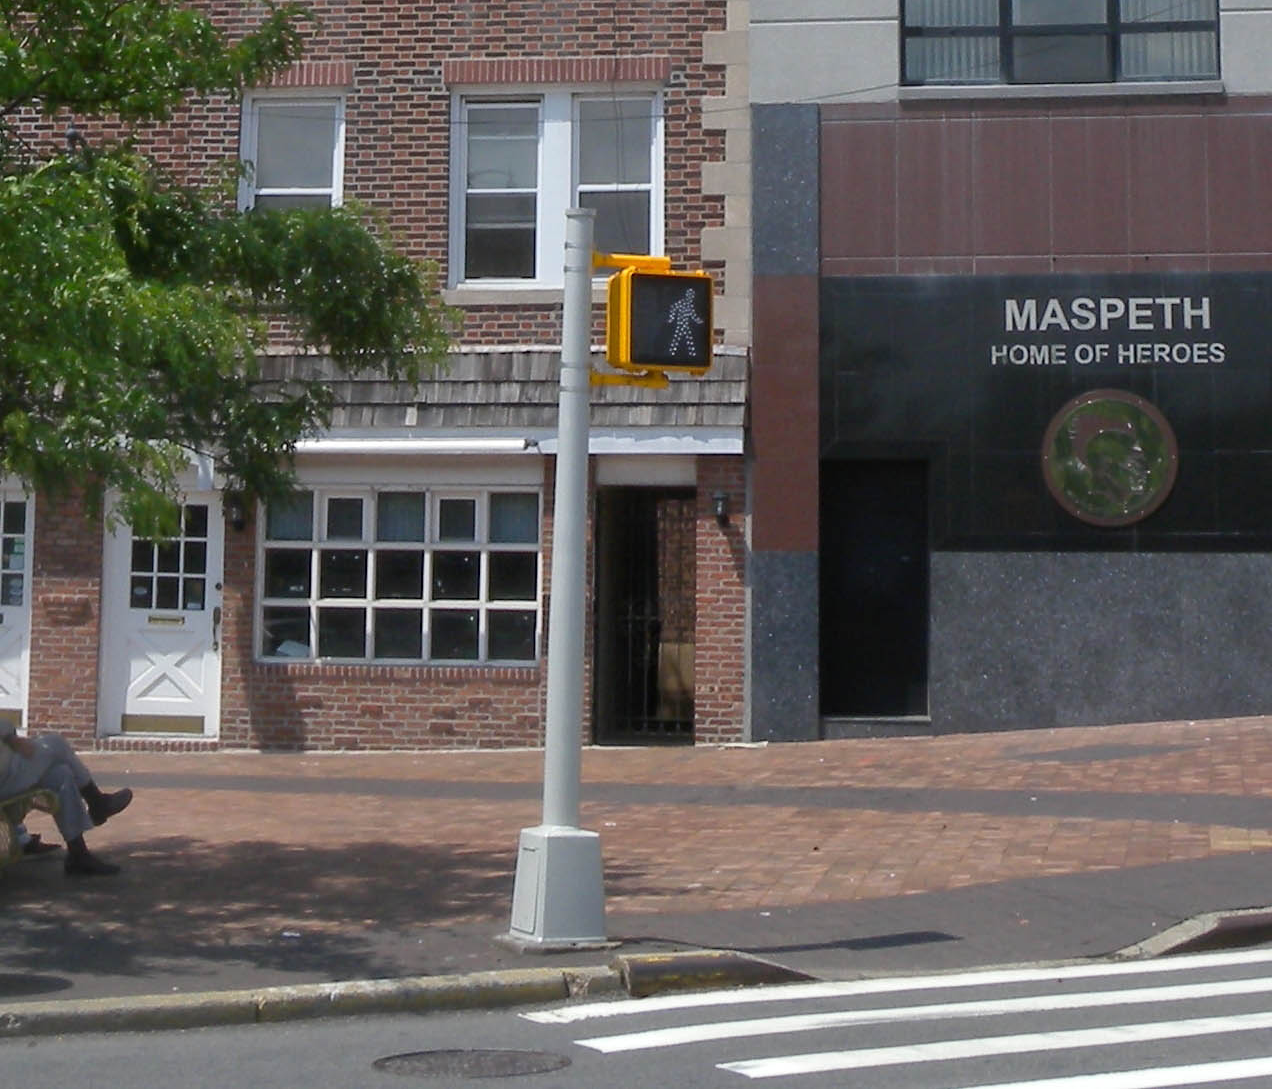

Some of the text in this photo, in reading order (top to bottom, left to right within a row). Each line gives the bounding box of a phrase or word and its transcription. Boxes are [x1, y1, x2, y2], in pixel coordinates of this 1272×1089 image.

[1004, 297, 1211, 331] MASPETH
[991, 343, 1226, 365] HOME OF HEROES
